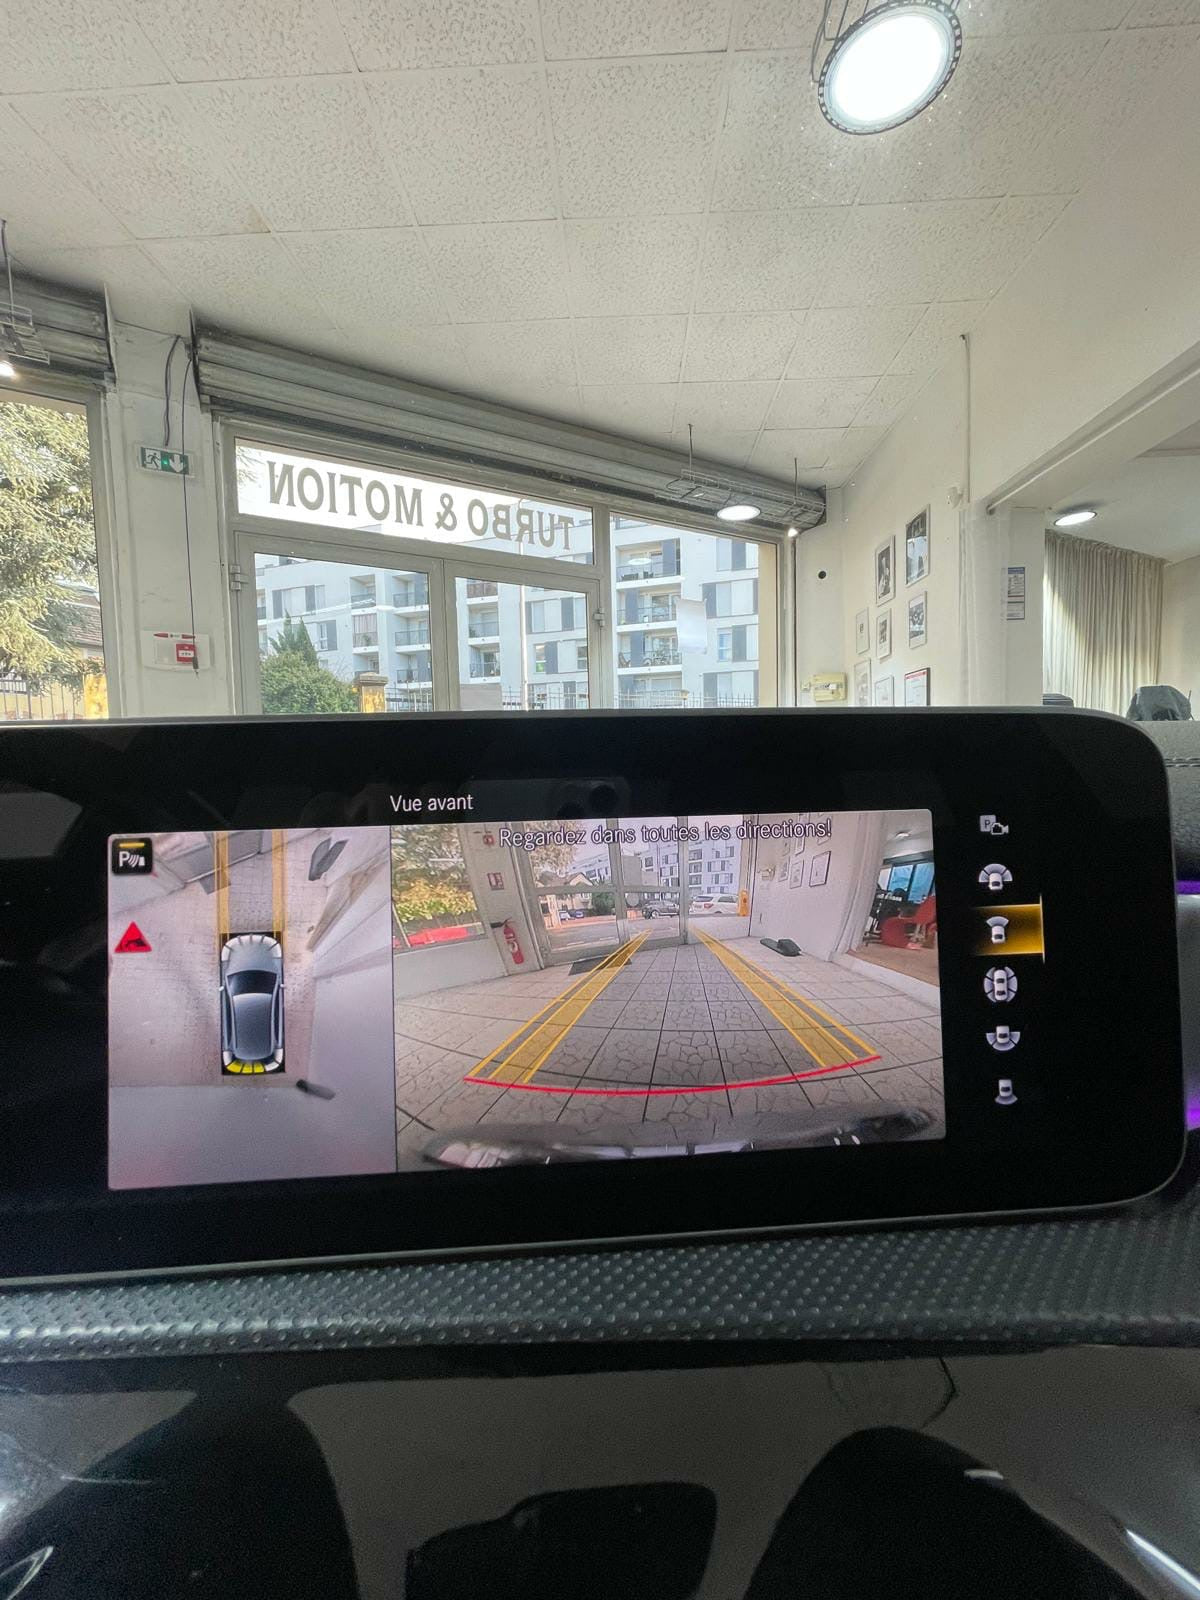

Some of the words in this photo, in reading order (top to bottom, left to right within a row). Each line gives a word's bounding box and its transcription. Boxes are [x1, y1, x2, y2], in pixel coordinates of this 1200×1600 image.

[390, 795, 422, 812] Vue
[427, 794, 474, 811] avant
[499, 828, 587, 850] Regardez
[591, 825, 636, 845] dans
[641, 824, 700, 843] toutes
[704, 822, 731, 841] les
[736, 819, 833, 841] directions!
